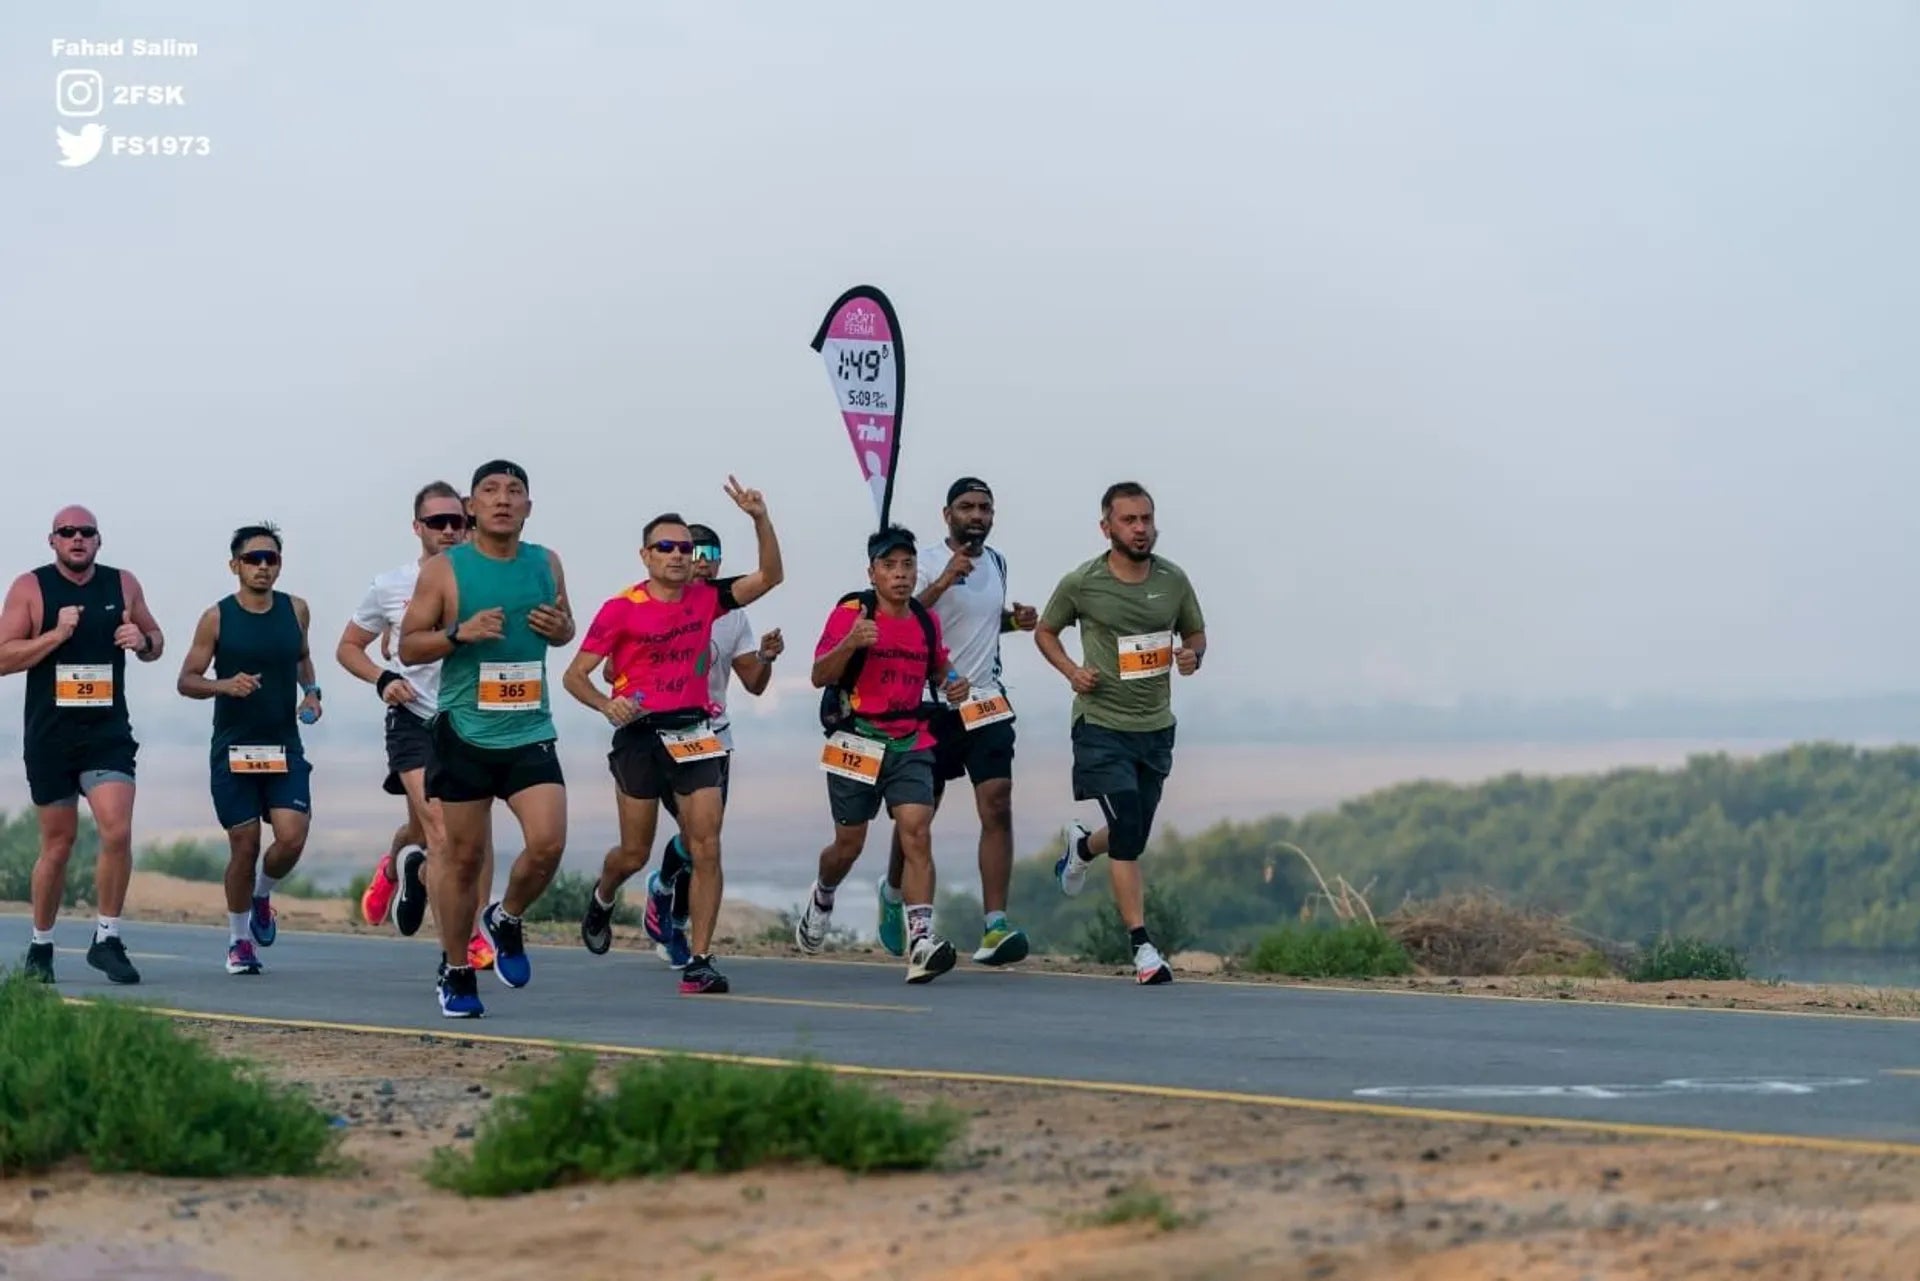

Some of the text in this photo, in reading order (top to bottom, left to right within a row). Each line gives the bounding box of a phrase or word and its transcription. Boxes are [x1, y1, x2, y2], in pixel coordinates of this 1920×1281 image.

[837, 349, 880, 382] 1:49
[848, 390, 871, 407] 5:09
[1139, 652, 1158, 665] 121
[77, 683, 94, 695] 29
[499, 683, 526, 697] 365
[683, 741, 704, 753] 115
[842, 752, 862, 768] 112
